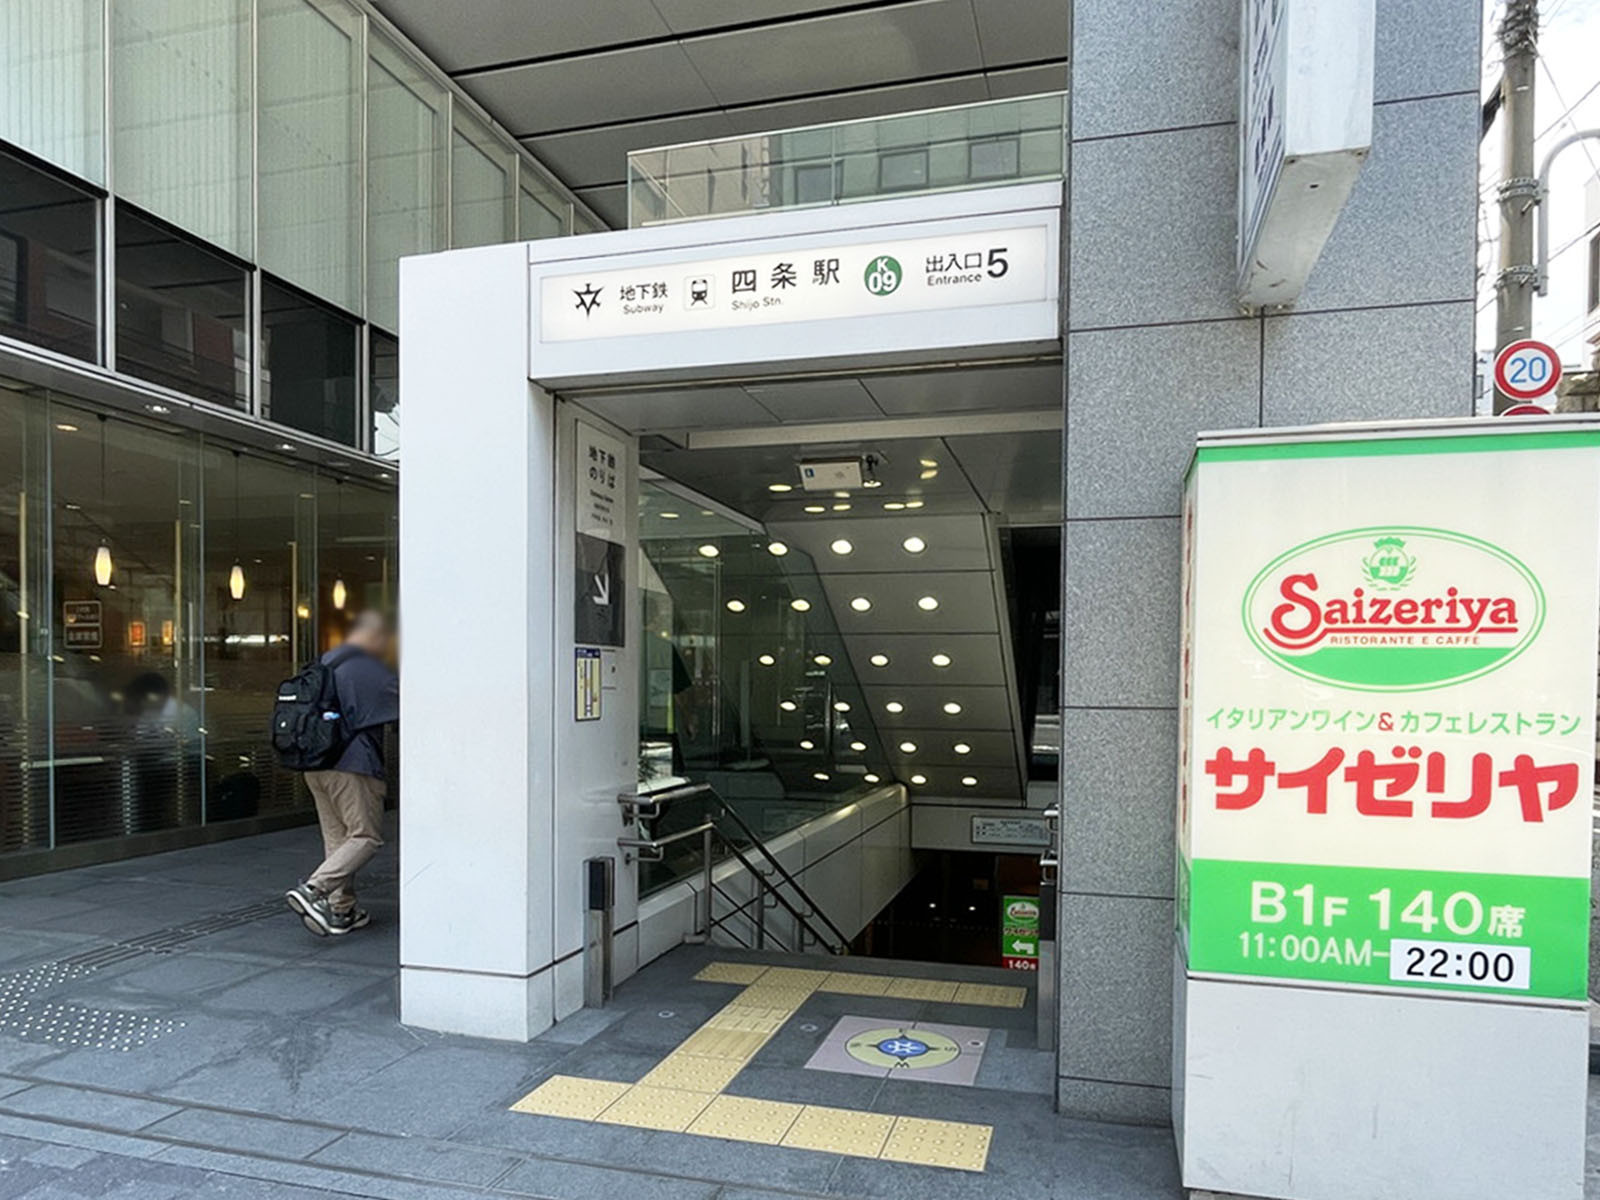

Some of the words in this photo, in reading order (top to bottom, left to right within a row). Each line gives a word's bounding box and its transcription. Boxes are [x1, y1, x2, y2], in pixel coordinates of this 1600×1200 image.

[877, 258, 888, 272] K
[925, 252, 982, 274] 出入口
[986, 248, 1009, 279] 5
[731, 258, 840, 294] 四条駅
[869, 271, 897, 293] 09
[927, 273, 982, 287] Entrance
[619, 281, 669, 302] 地下鉄
[623, 304, 664, 316] Subway
[731, 300, 760, 312] Shijo
[1509, 356, 1546, 383] 20
[1269, 573, 1519, 641] Saizeriya
[1330, 635, 1415, 646] RISTORANTE
[1421, 635, 1430, 645] E
[1205, 745, 1580, 823] サイゼリヤ
[1251, 880, 1349, 927] B1F
[1406, 946, 1515, 983] 22:00
